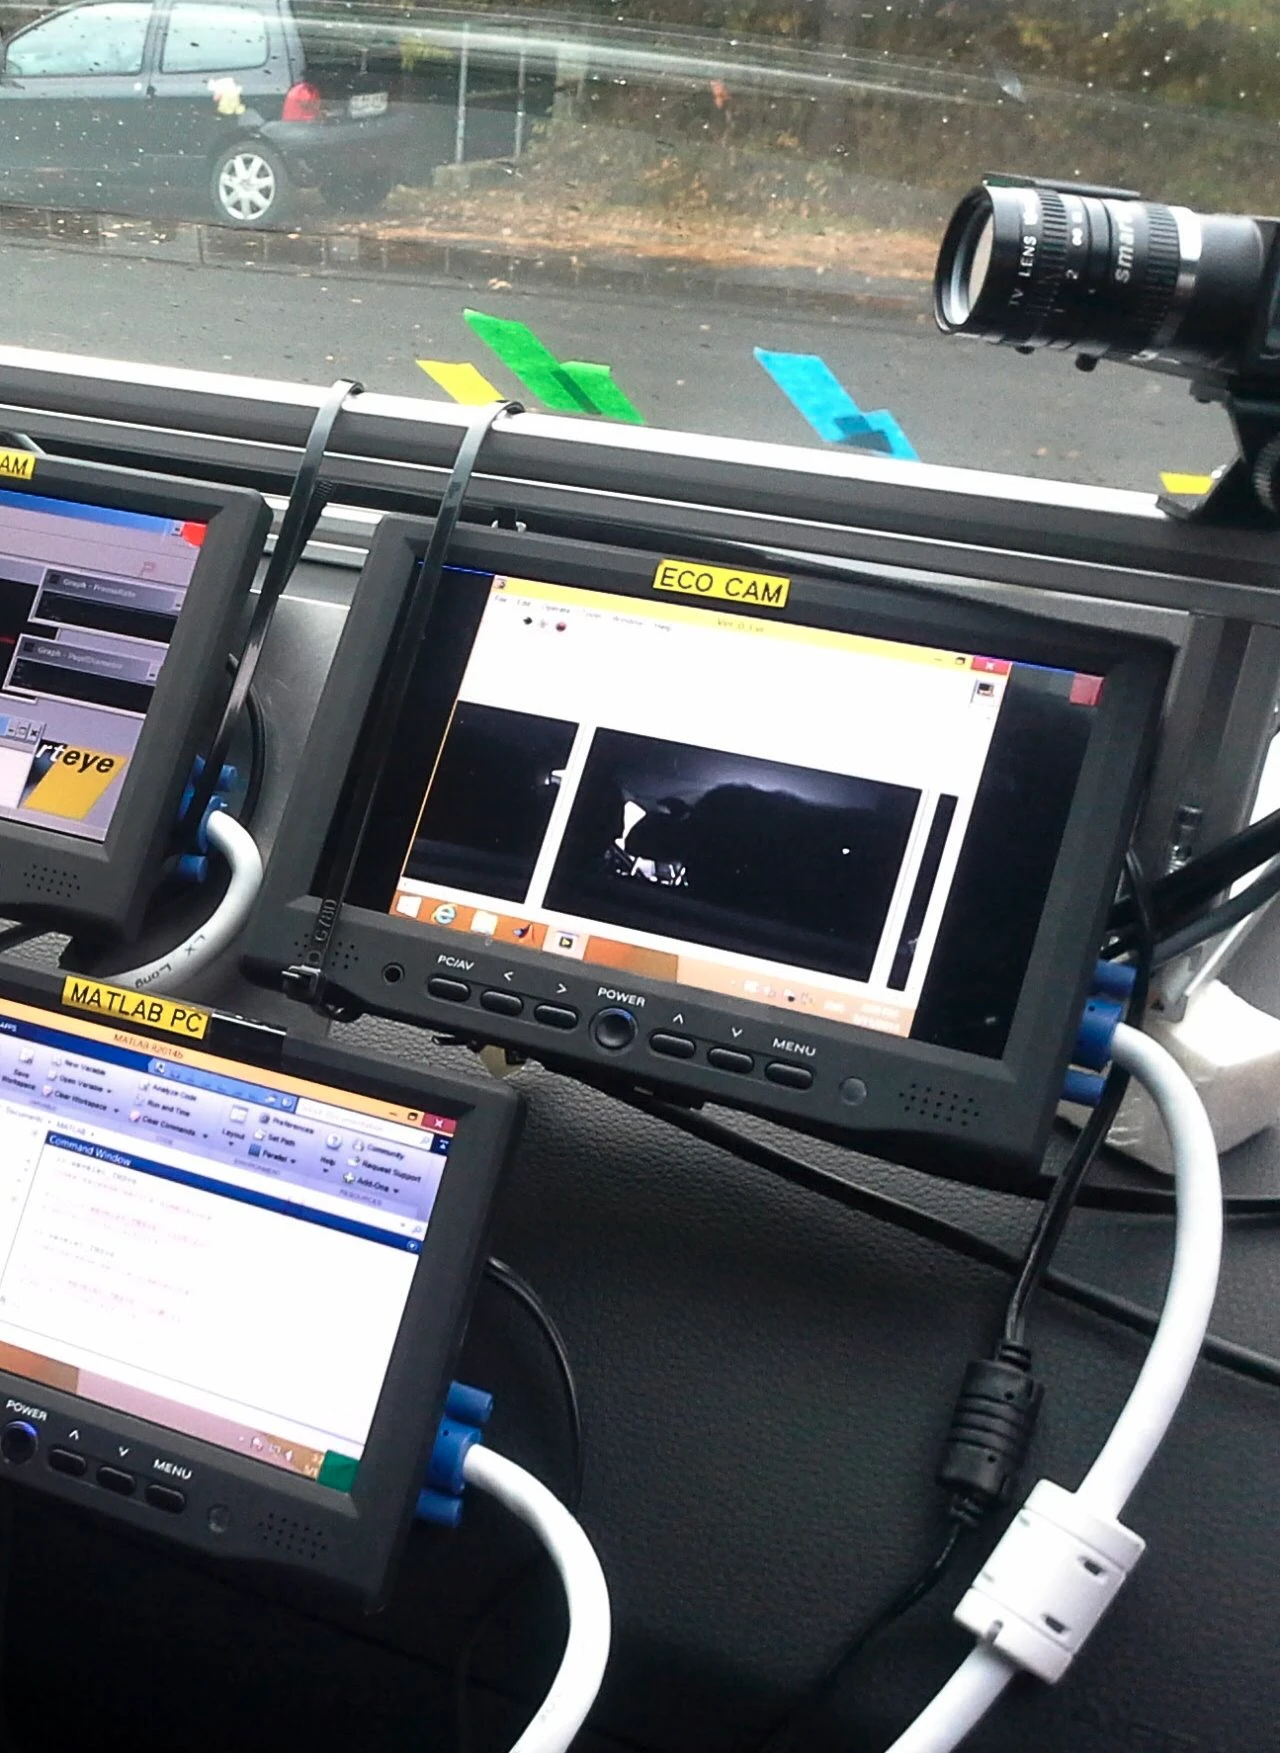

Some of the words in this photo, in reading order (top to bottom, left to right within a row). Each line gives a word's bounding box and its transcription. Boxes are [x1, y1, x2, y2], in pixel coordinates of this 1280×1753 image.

[1019, 234, 1038, 279] LENS
[62, 577, 87, 590] Graph
[660, 565, 713, 594] ECO
[725, 577, 784, 605] CAM
[437, 953, 475, 972] PC/AV
[134, 962, 173, 990] Long
[597, 985, 646, 1008] POWER
[71, 982, 165, 1023] MATLAB
[170, 1008, 203, 1033] PC
[0, 1020, 18, 1033] APPS
[113, 1033, 150, 1051] MATLAB
[151, 1042, 184, 1060] R2014b
[772, 1037, 817, 1057] MENU
[152, 1083, 179, 1099] Analyze
[221, 1127, 245, 1142] Layout
[272, 1116, 315, 1135] Preferences
[48, 1134, 95, 1157] Command
[94, 1147, 133, 1168] Window
[262, 1148, 289, 1163] Parallel
[366, 1142, 406, 1162] Community
[319, 1155, 337, 1169] Help
[361, 1157, 393, 1177] Request
[392, 1166, 422, 1184] Support
[6, 1399, 48, 1422] POWER
[153, 1458, 193, 1481] MENU
